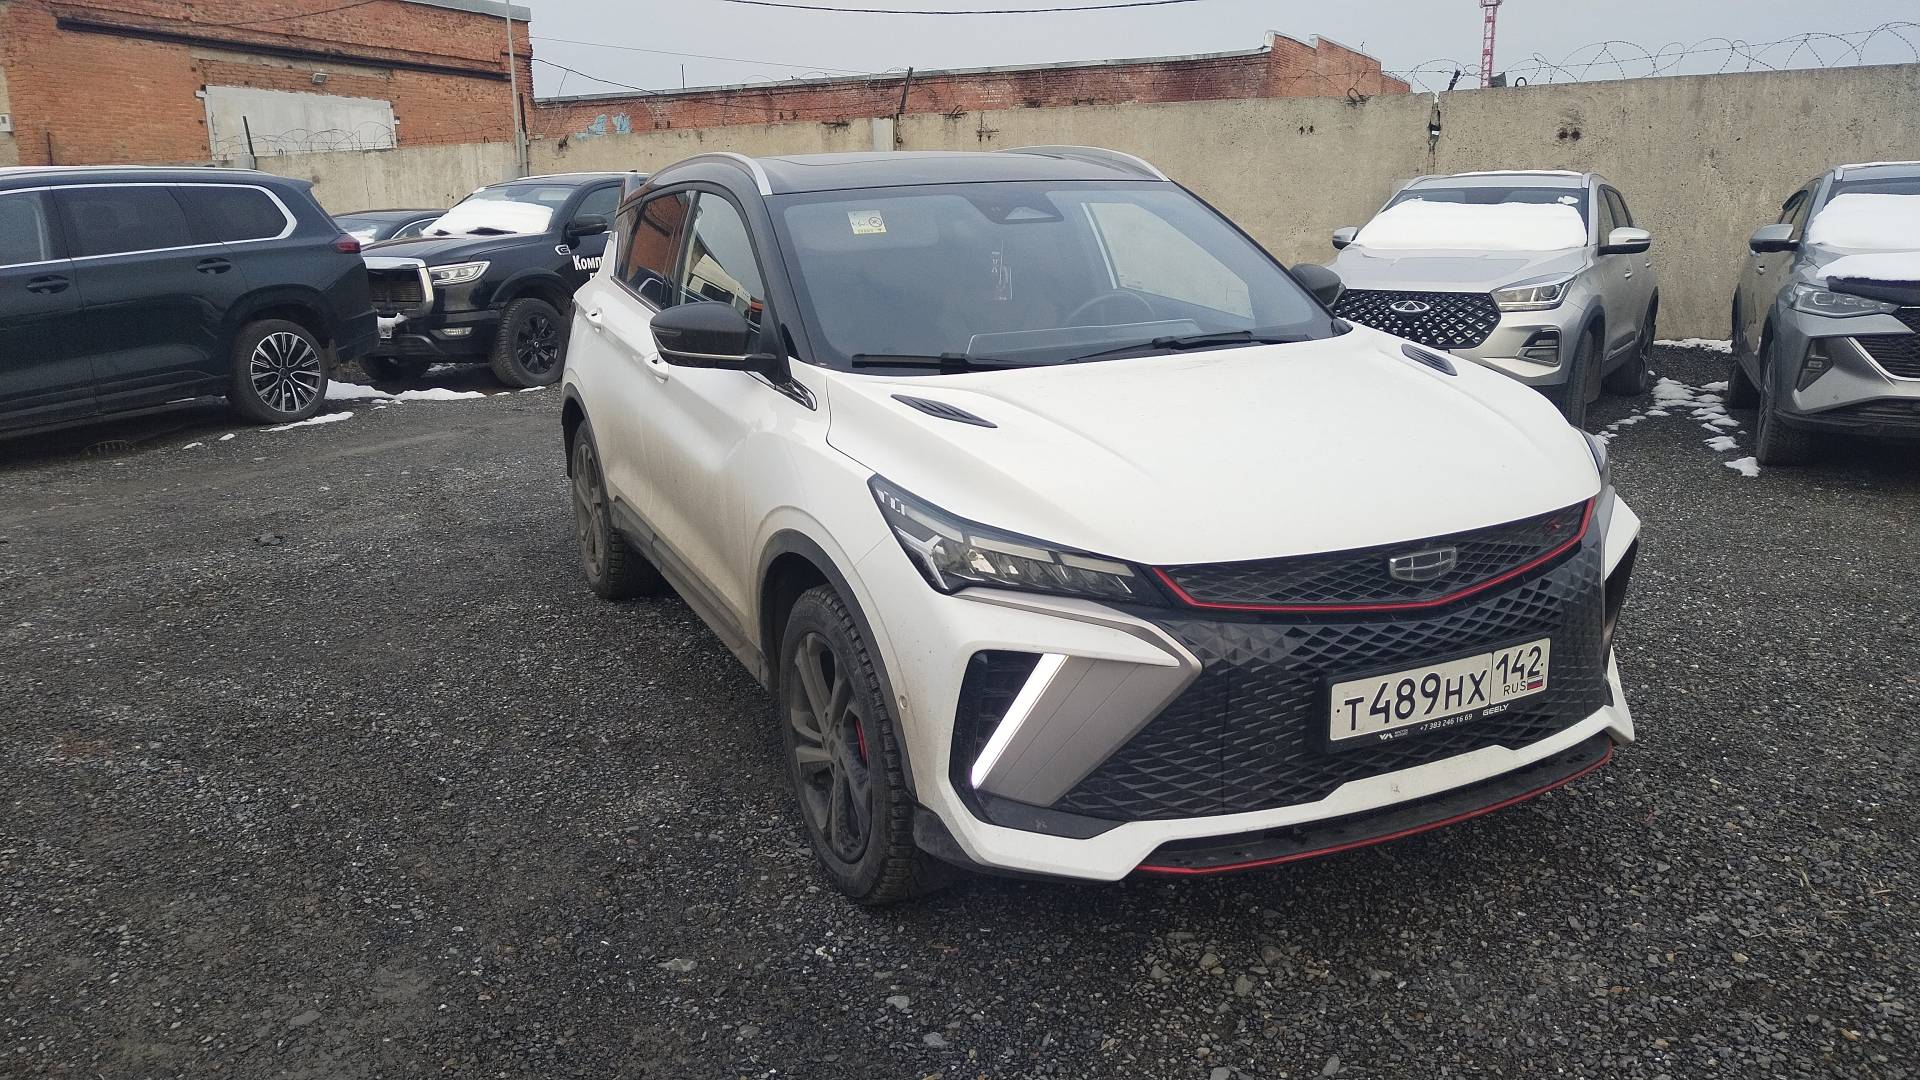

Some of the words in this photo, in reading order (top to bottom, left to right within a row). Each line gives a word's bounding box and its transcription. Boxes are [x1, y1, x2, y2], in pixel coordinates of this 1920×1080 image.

[572, 255, 603, 271] Комп
[1496, 646, 1542, 684] 142
[1503, 681, 1526, 696] RUS
[1464, 713, 1473, 721] 69
[1483, 704, 1509, 716] GEELY
